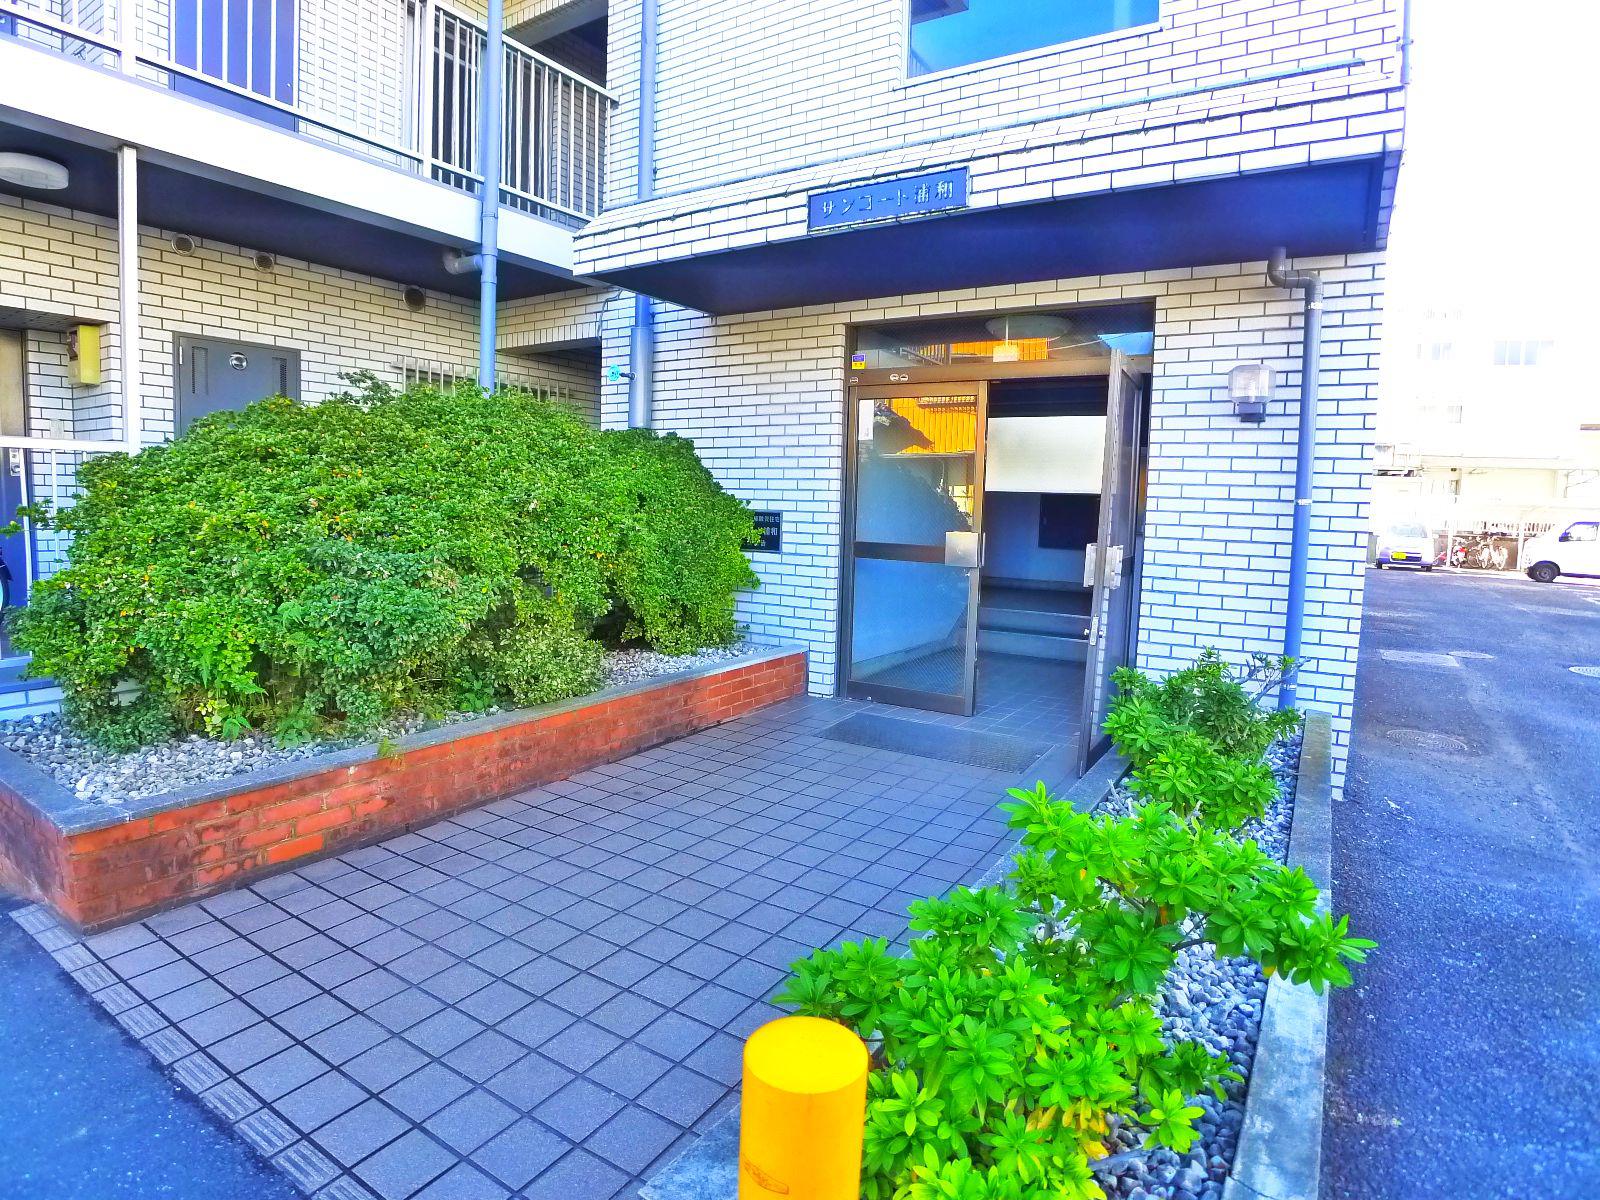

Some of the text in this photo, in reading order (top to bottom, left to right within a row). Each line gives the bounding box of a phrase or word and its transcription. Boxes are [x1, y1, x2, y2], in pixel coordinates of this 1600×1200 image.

[822, 179, 954, 219] サンコート浦和
